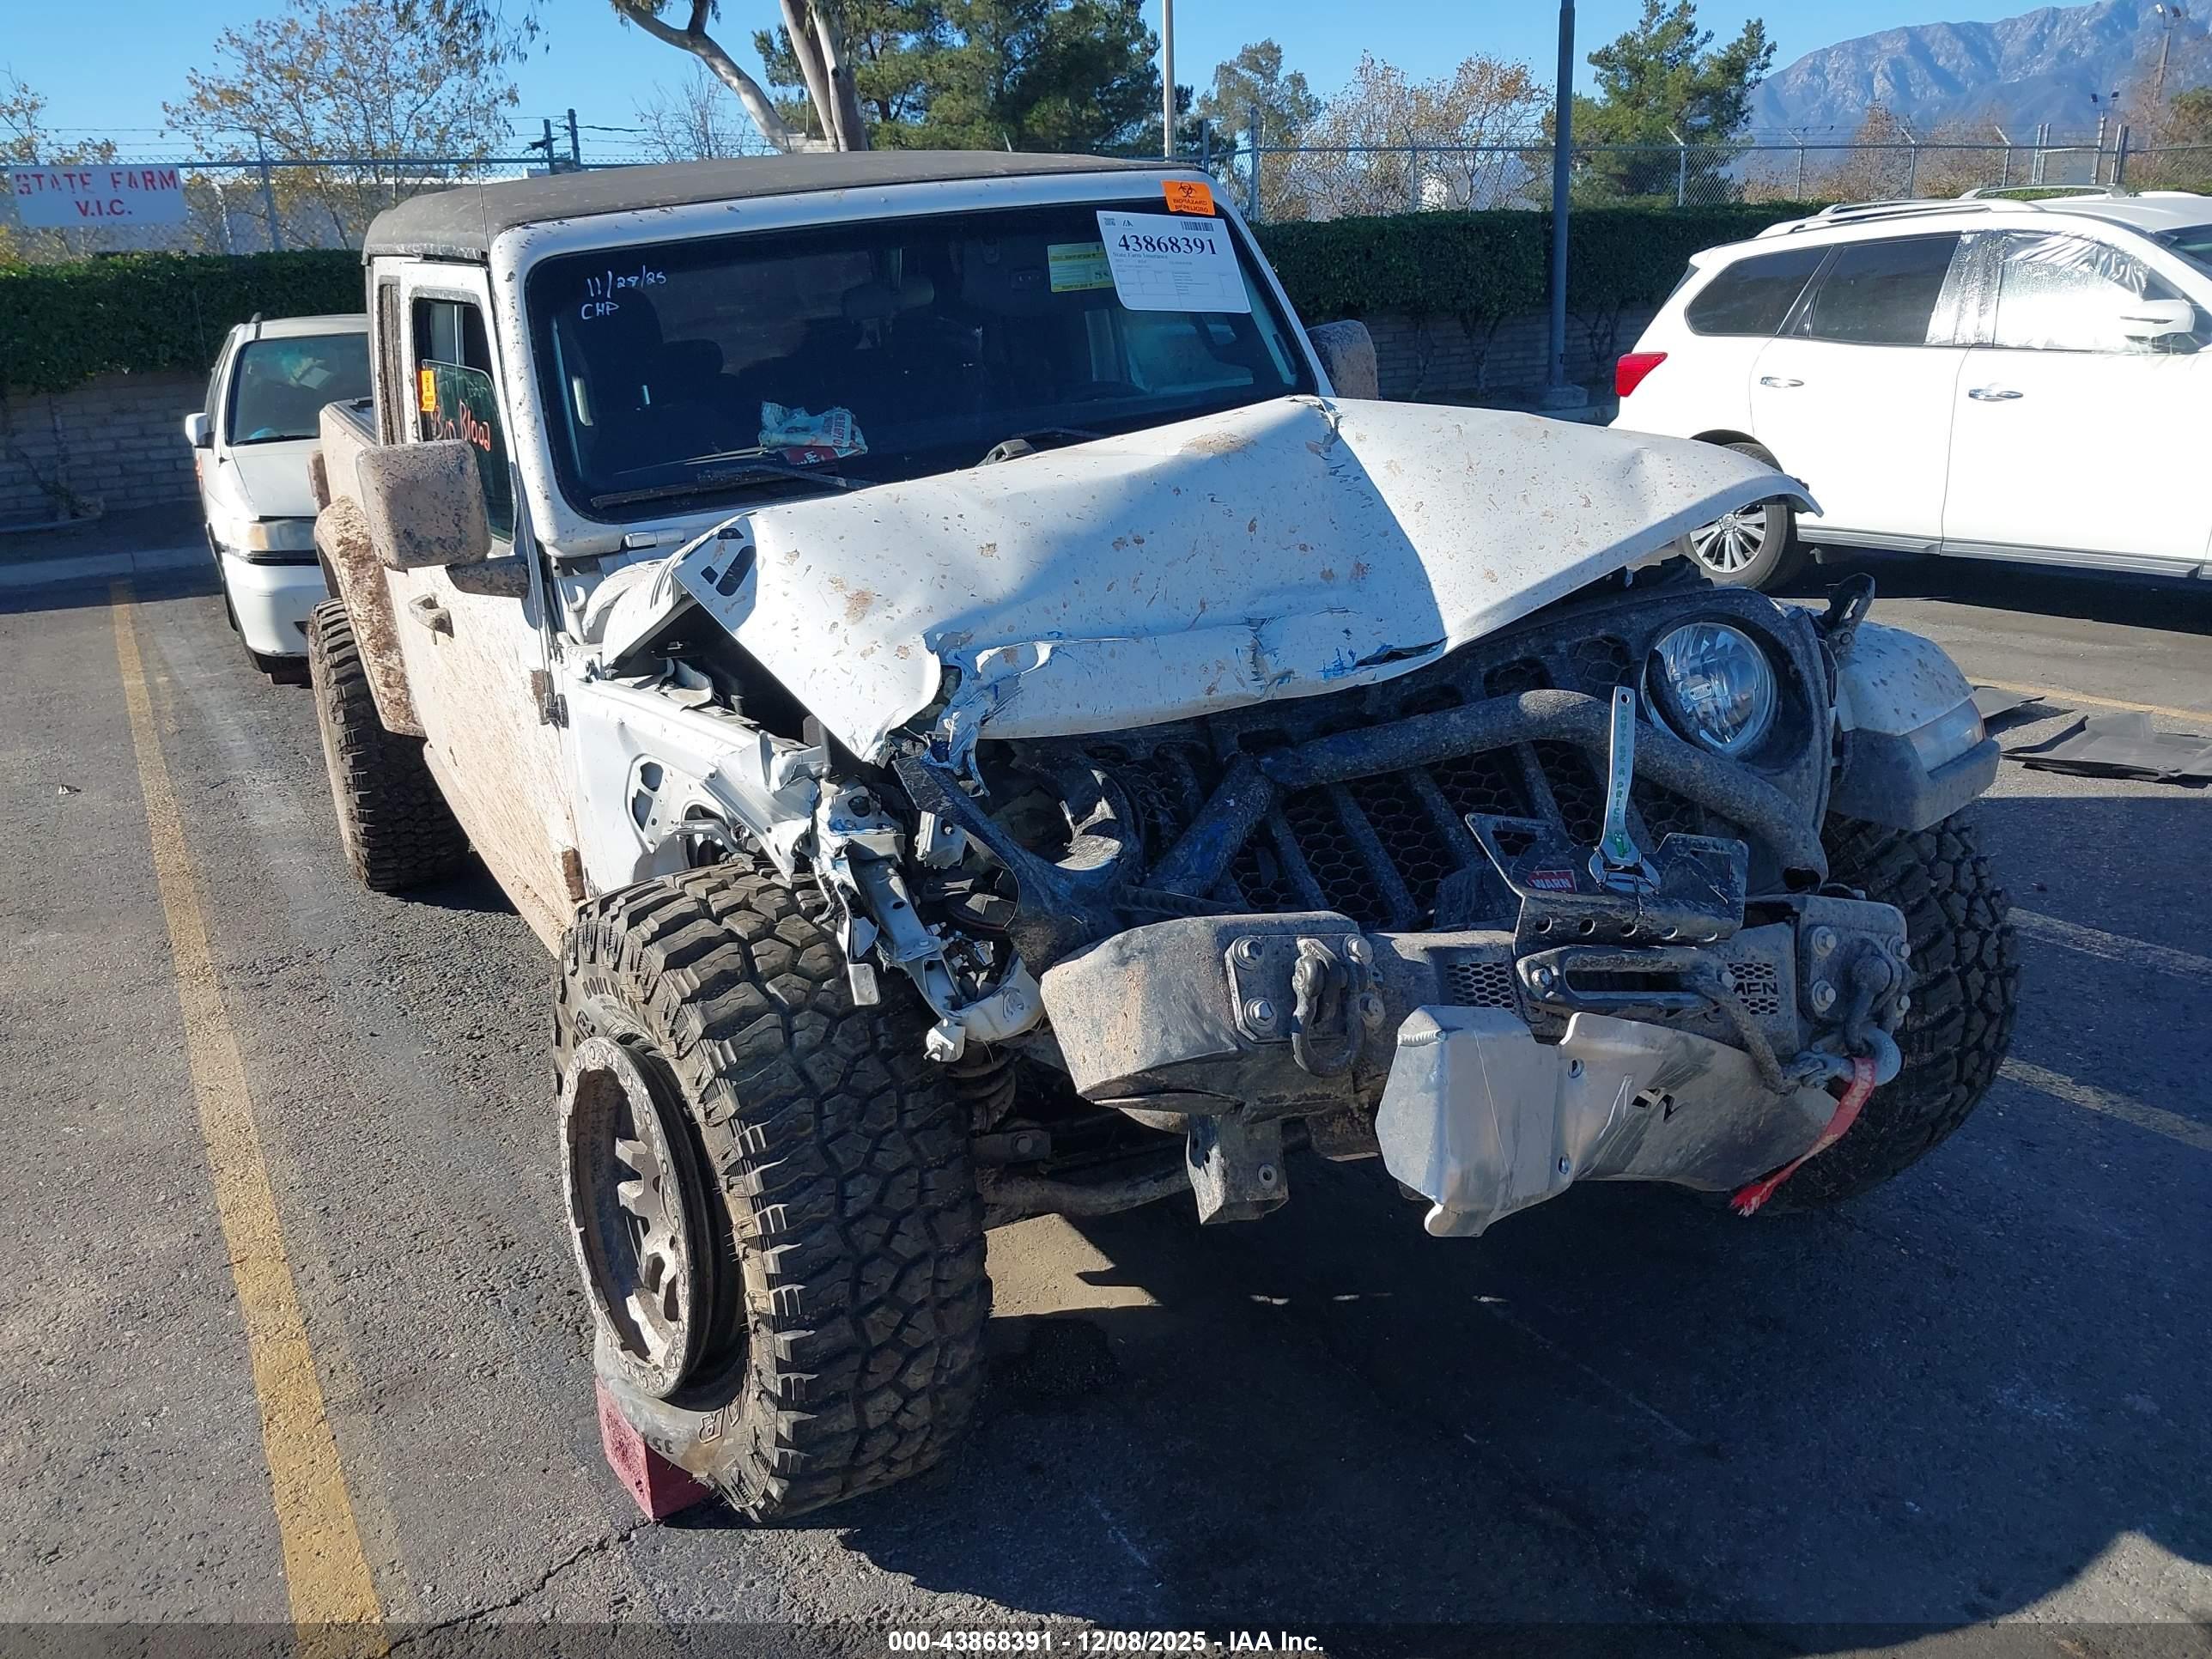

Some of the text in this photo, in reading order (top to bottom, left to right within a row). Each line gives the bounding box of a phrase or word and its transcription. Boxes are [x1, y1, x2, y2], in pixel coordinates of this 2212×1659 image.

[15, 169, 178, 195] STATE FARM
[75, 198, 133, 216] V.I.C.
[1118, 234, 1218, 255] 43868391
[580, 301, 620, 320] CHP
[1531, 878, 1573, 890] WARN
